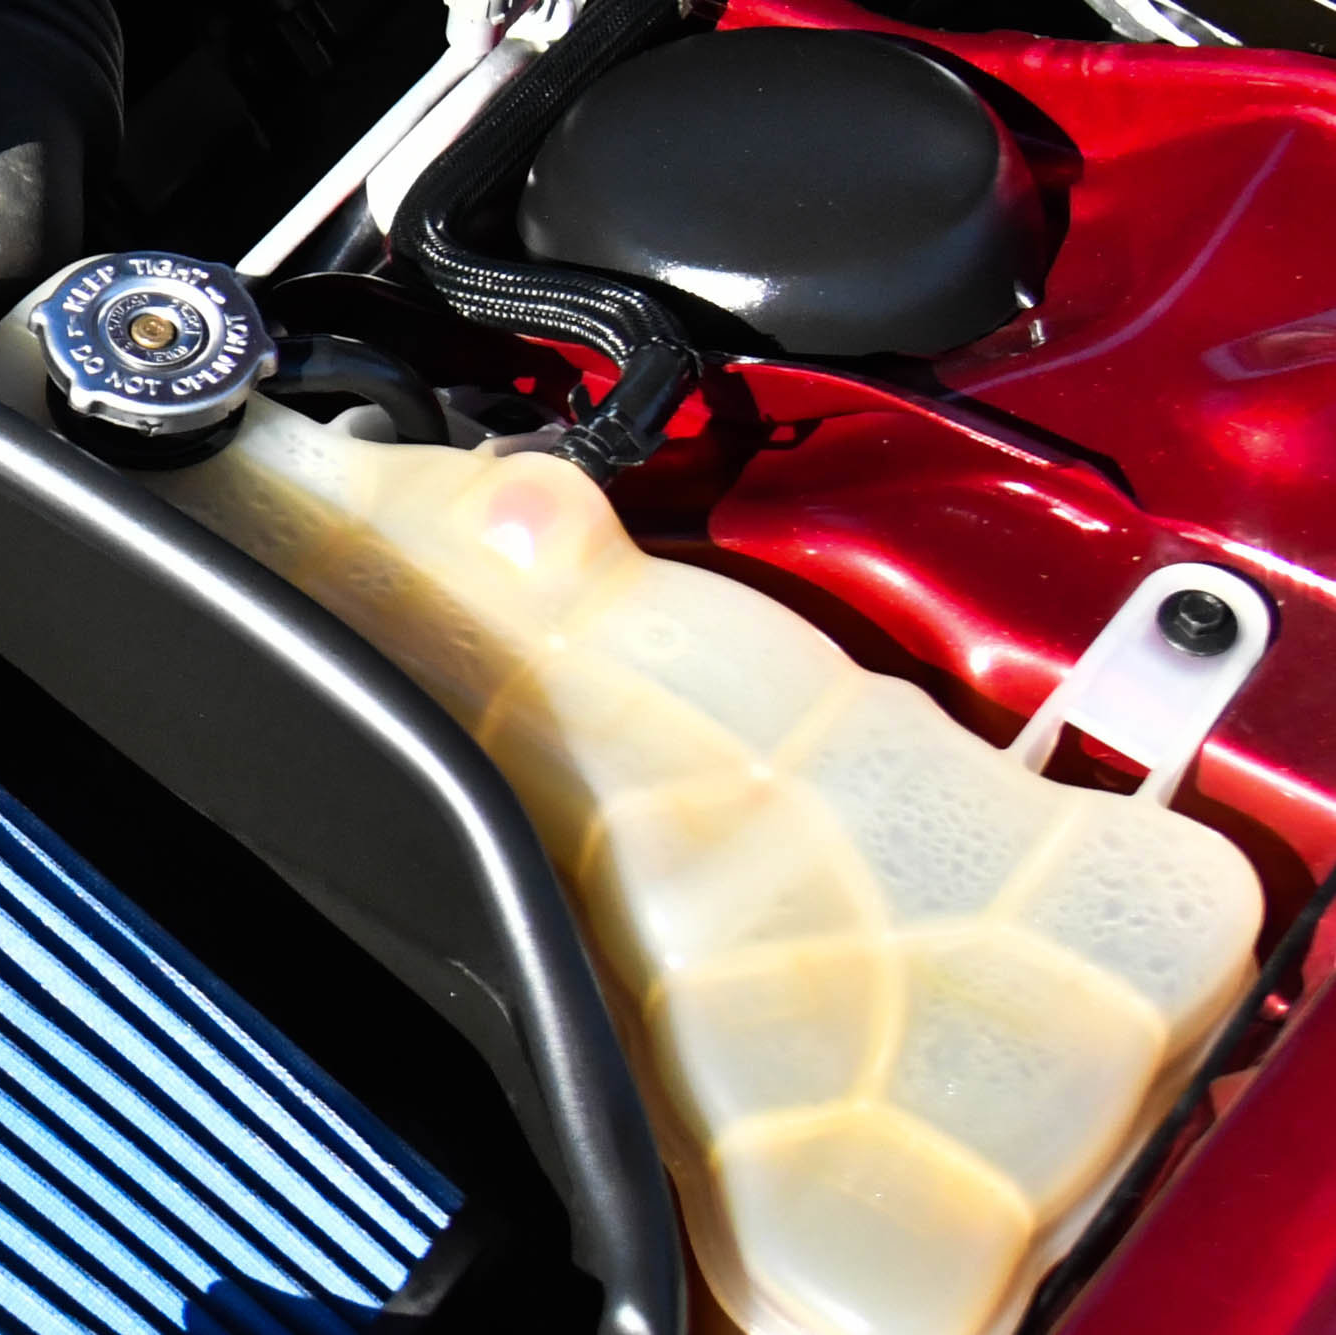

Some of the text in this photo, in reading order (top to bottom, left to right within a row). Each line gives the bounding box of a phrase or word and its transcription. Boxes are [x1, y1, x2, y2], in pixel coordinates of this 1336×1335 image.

[62, 258, 209, 313] KEEP TIGHT
[71, 345, 105, 375] DO
[105, 371, 162, 397] NOT
[171, 353, 237, 396] OPEN
[223, 314, 250, 356] HOT
